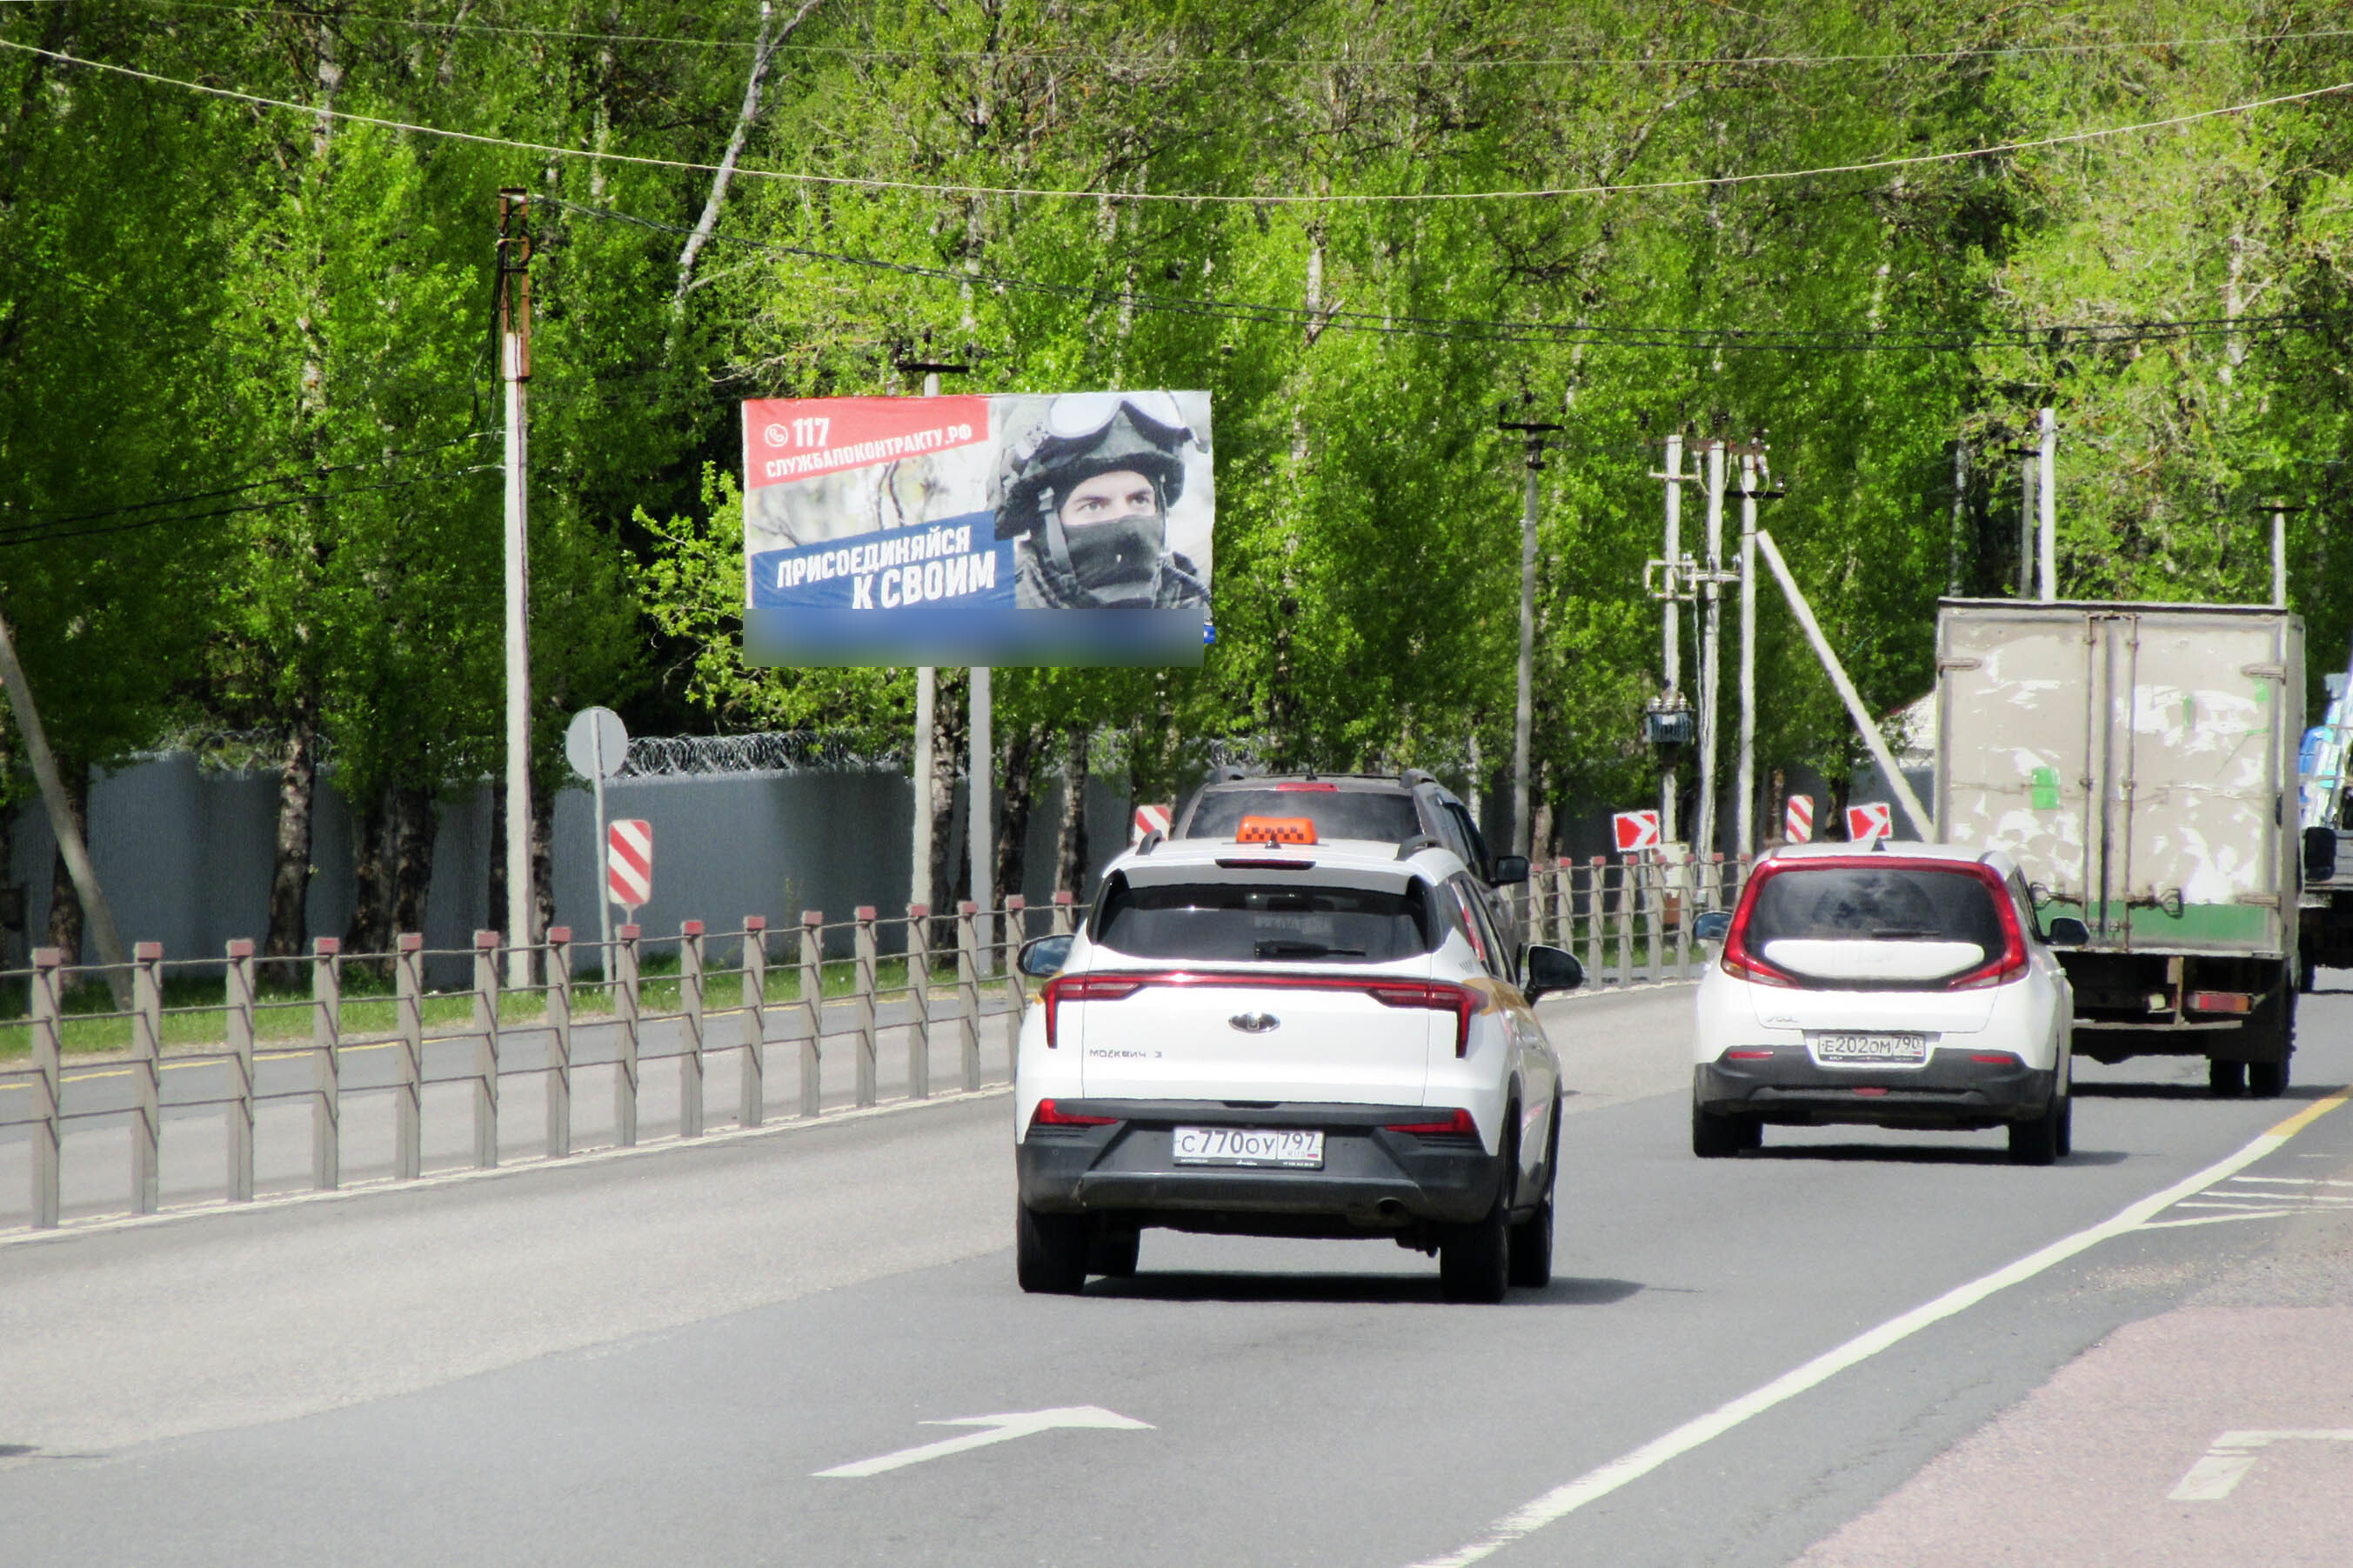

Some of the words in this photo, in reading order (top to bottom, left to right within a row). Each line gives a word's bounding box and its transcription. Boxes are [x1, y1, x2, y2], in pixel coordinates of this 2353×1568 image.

[765, 424, 973, 478] СЛУЖБАПОКОНТРАКТУ.РФ
[792, 417, 830, 448] 117
[777, 525, 972, 589] ПРИСОЕДИНЯЙСЯ
[852, 574, 875, 609] К
[880, 550, 996, 609] СВОИМ
